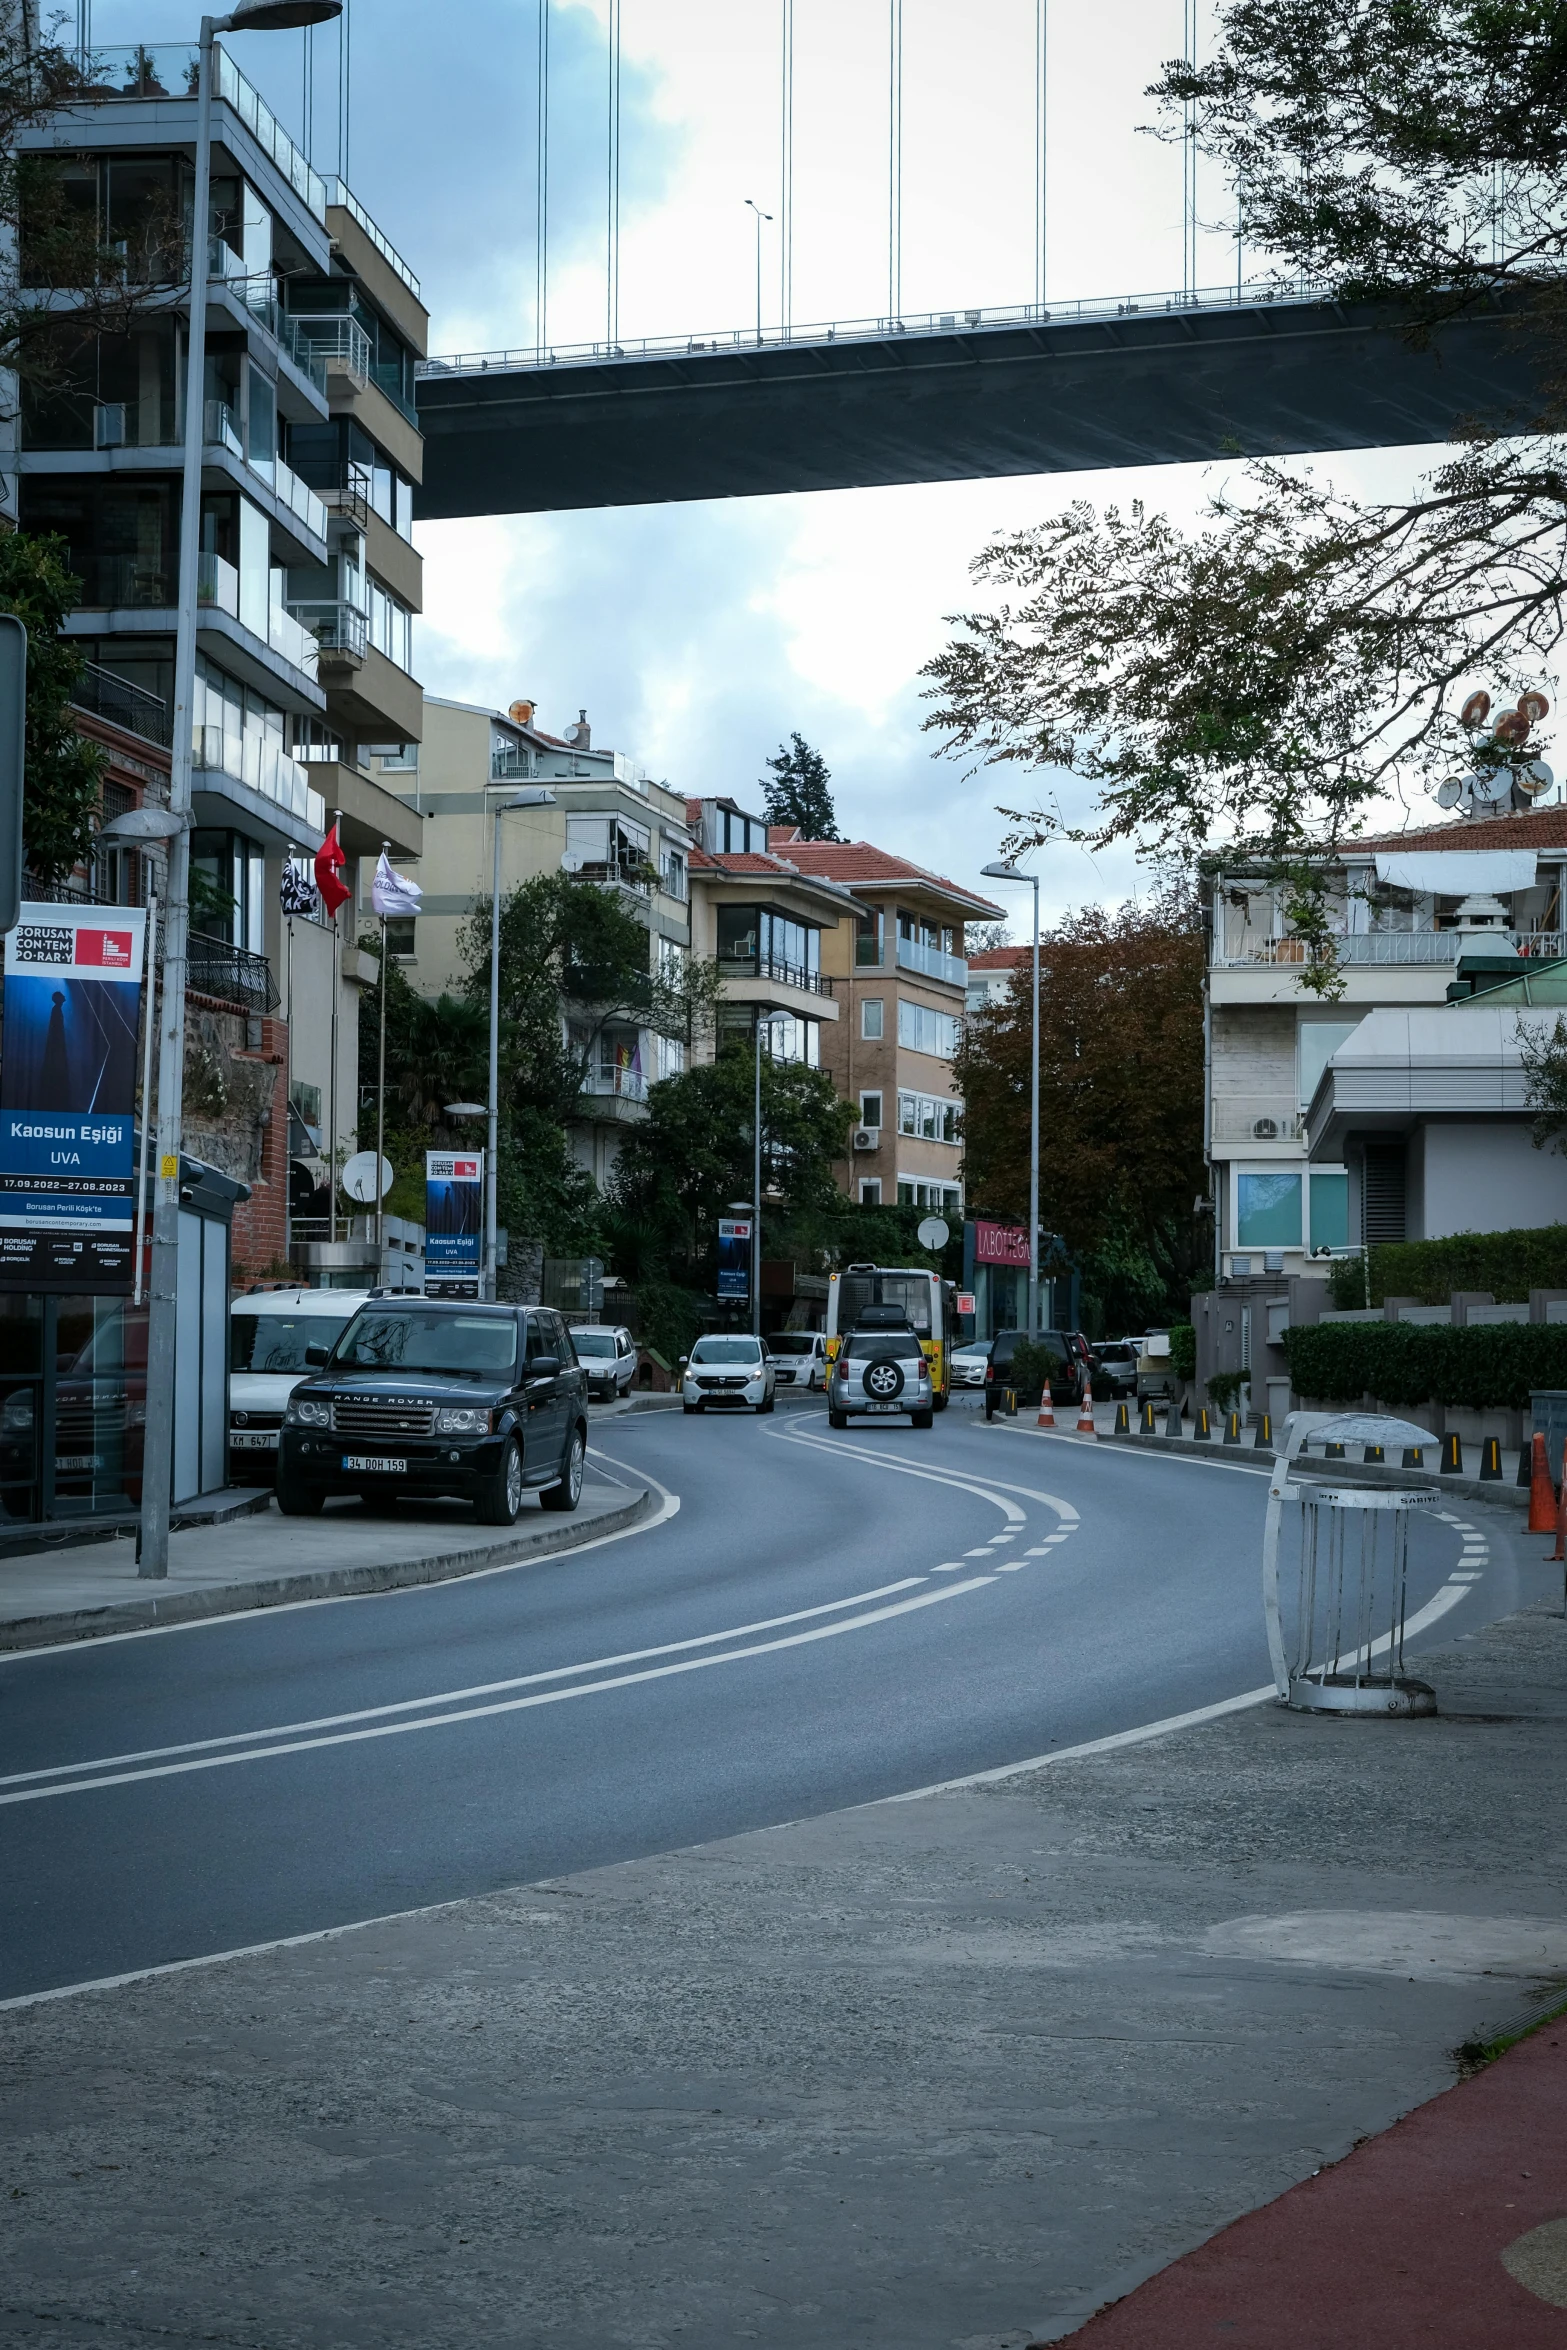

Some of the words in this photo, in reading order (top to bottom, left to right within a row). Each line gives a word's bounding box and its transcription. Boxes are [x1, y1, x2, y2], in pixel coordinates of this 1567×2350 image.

[17, 927, 73, 939] BORUSAN
[11, 1123, 75, 1140] Kaosun
[81, 1126, 122, 1144] Eşiği
[51, 1152, 80, 1165] UVA
[26, 1203, 55, 1211] Borusan
[26, 1219, 101, 1228] borusancontemporary.com
[962, 1299, 971, 1311] E
[233, 1436, 244, 1446] KM
[251, 1436, 267, 1446] 647
[349, 1458, 360, 1469] 34
[365, 1459, 384, 1471] DOH
[387, 1460, 405, 1471] 159
